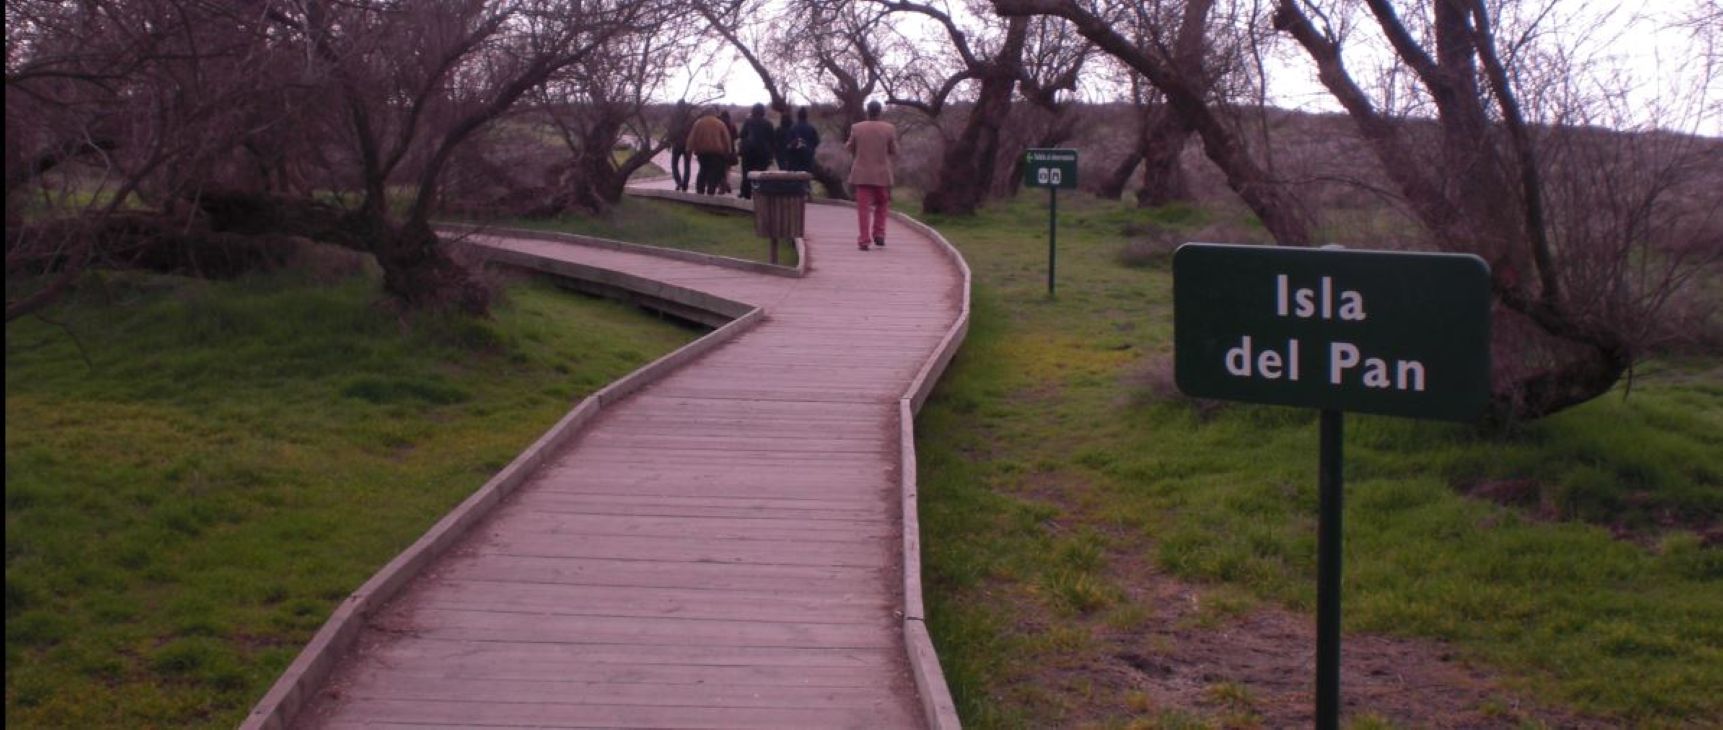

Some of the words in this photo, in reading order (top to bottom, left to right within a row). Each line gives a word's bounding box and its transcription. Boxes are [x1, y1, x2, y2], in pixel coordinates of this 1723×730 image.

[1276, 273, 1366, 321] Isla
[1225, 335, 1300, 381] del
[1329, 341, 1426, 391] Pan
